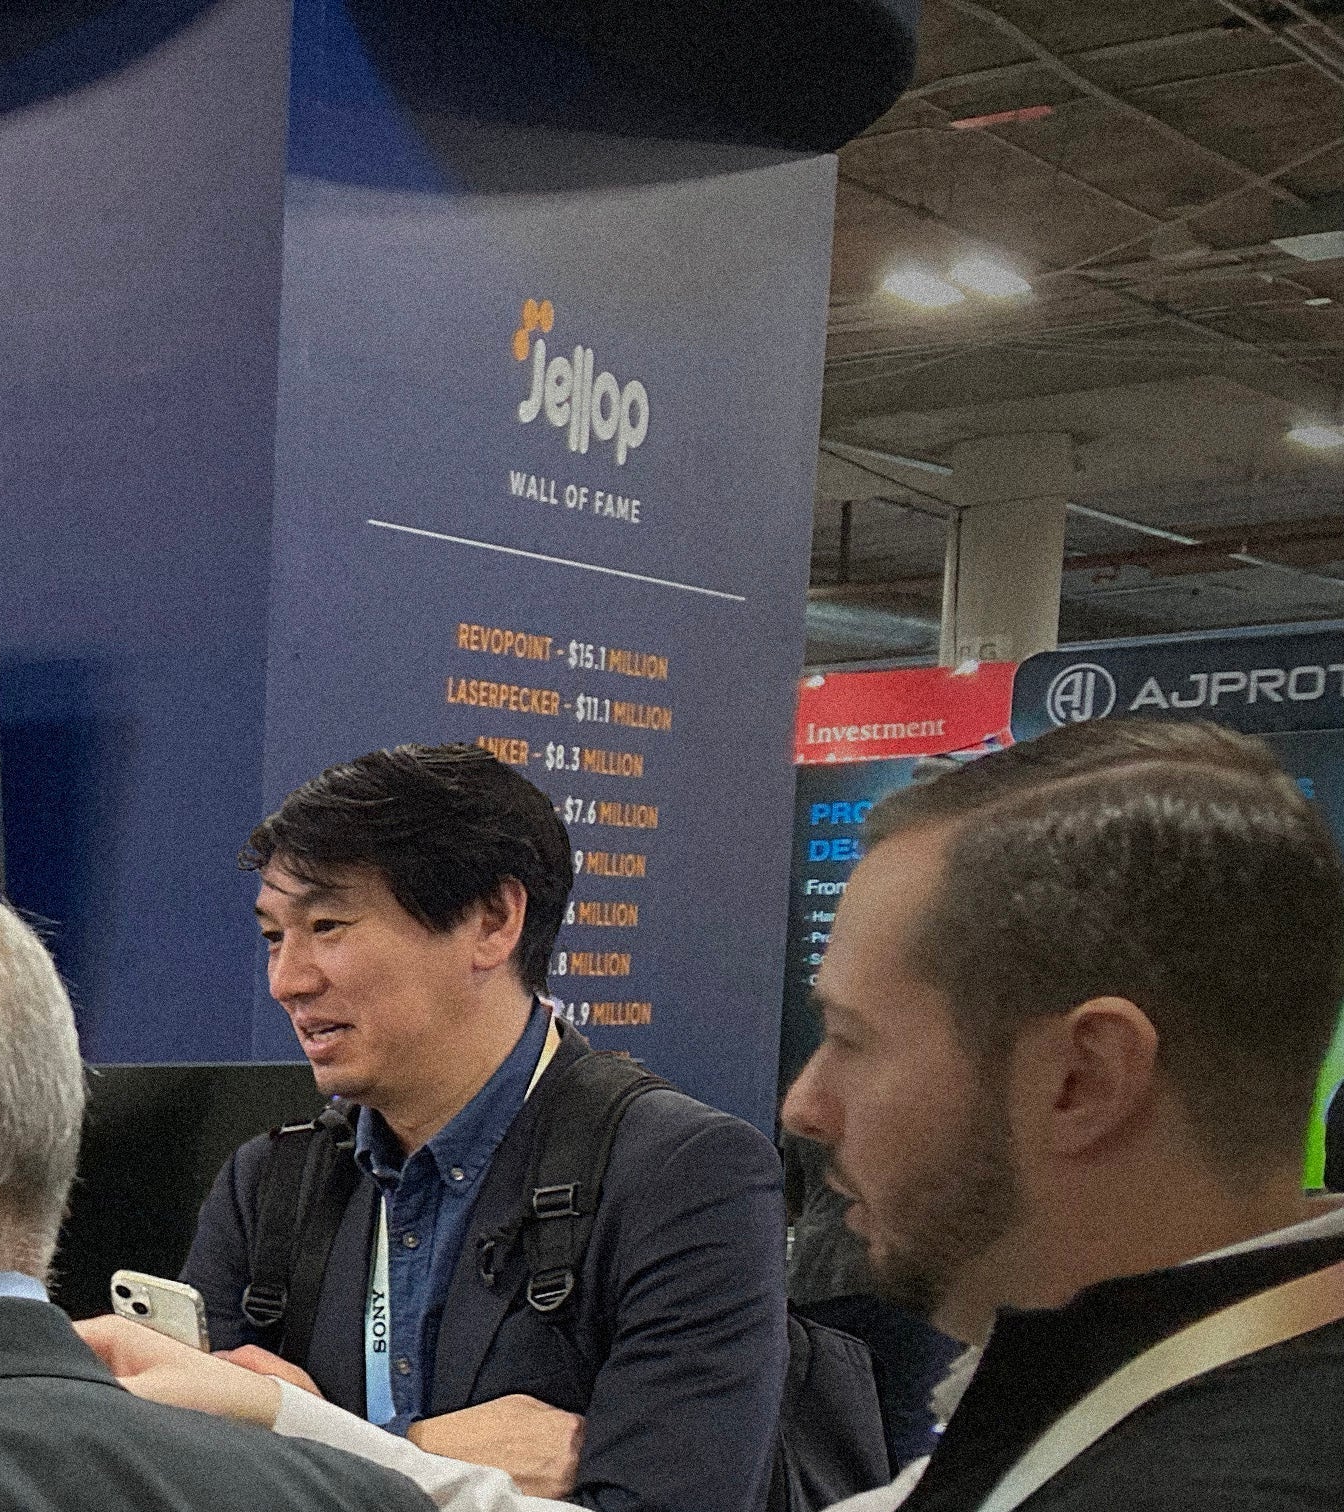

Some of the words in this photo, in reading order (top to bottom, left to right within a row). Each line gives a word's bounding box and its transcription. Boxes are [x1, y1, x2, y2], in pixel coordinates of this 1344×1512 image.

[518, 337, 649, 465] jellop
[510, 471, 558, 505] WALL
[565, 485, 588, 510] OF
[594, 491, 641, 524] FAME
[457, 623, 552, 661] REVOPOINT
[568, 639, 606, 672] $15.1
[608, 648, 669, 680] MILLION
[446, 676, 560, 716] LASERPECKER
[575, 693, 611, 723] $11.1
[612, 700, 672, 730] MILLION
[806, 717, 945, 745] Investment
[545, 741, 581, 771] $8.3
[582, 748, 643, 778] MILLION
[564, 796, 597, 825] $7.6
[598, 803, 659, 829] MILLION
[585, 851, 646, 877] MILLION
[578, 901, 638, 926] MILLION
[570, 952, 630, 975] MILLION
[591, 1002, 652, 1025] MILLION
[372, 1289, 387, 1353] SONY
